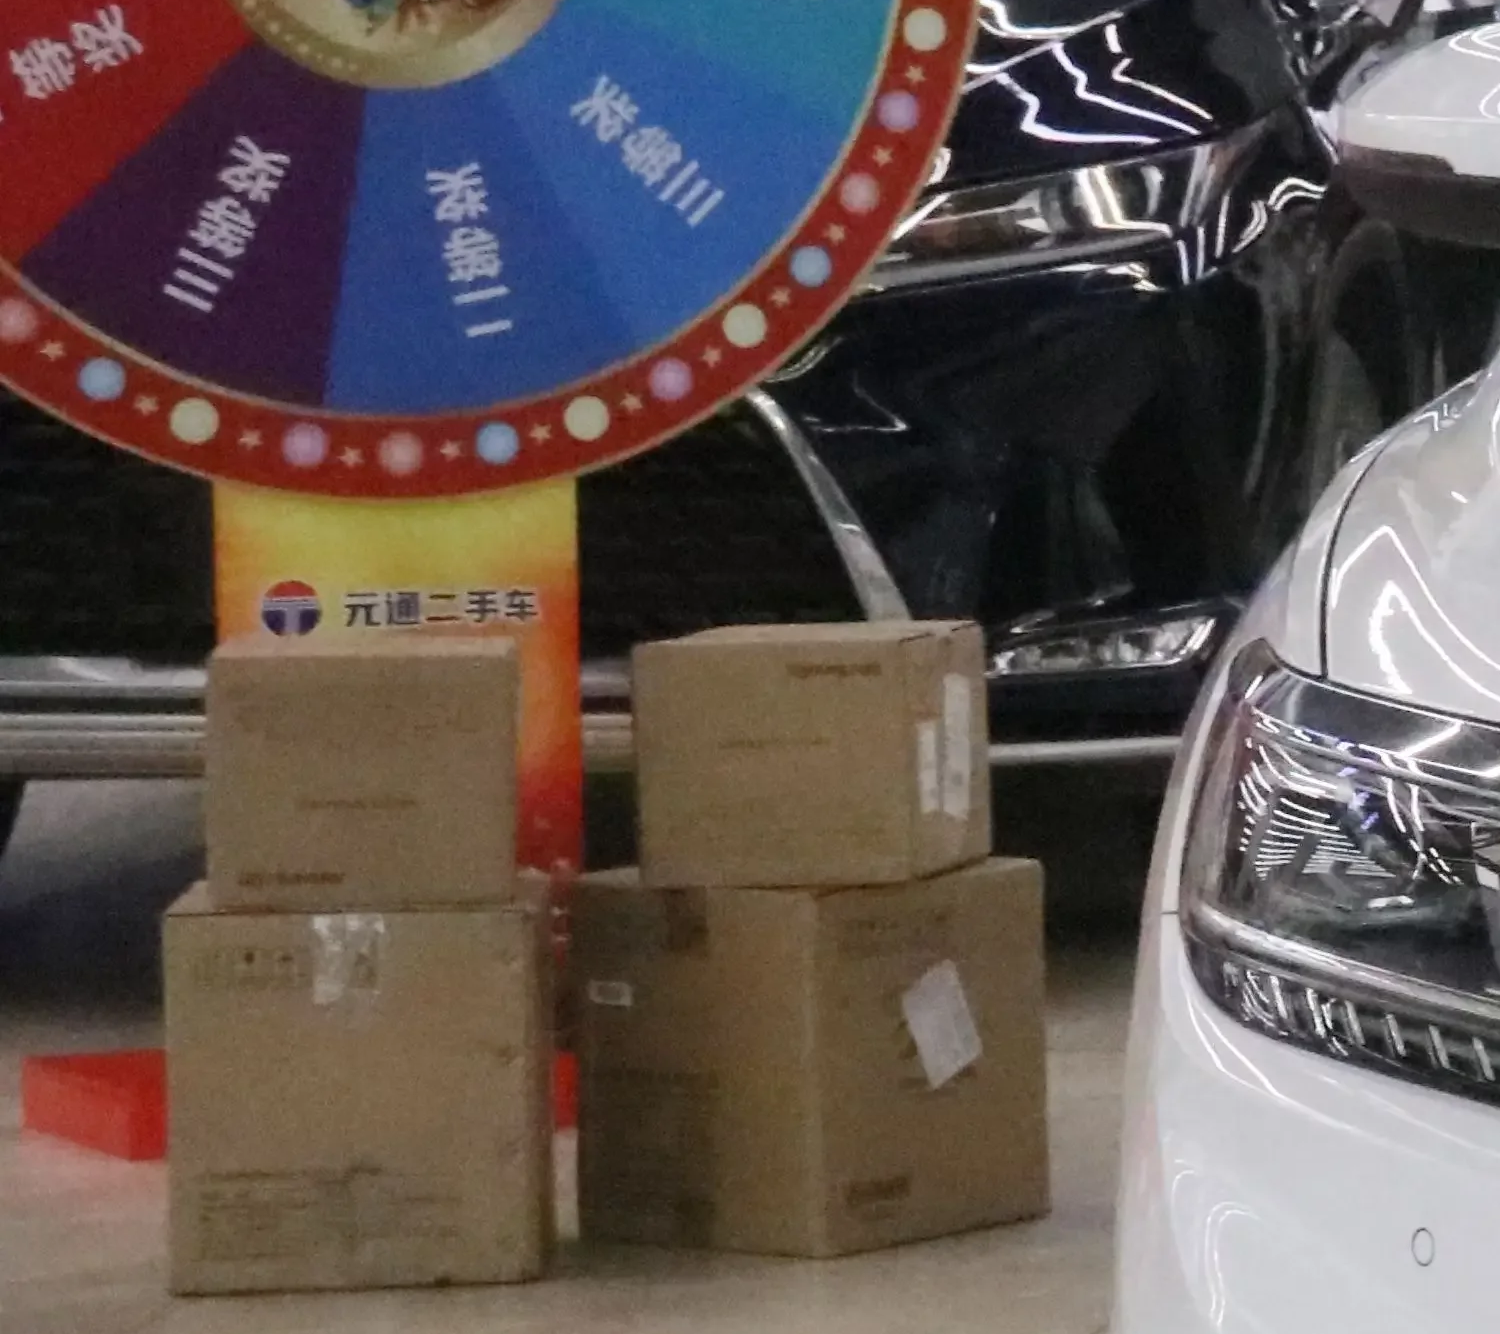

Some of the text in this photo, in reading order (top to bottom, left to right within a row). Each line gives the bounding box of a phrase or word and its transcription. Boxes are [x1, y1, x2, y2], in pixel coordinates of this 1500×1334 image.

[4, 4, 144, 101] 等奖
[163, 134, 292, 313] 三等奖
[569, 74, 725, 228] 三等奖
[425, 162, 514, 338] 二等奖
[343, 588, 538, 627] 元通二手车
